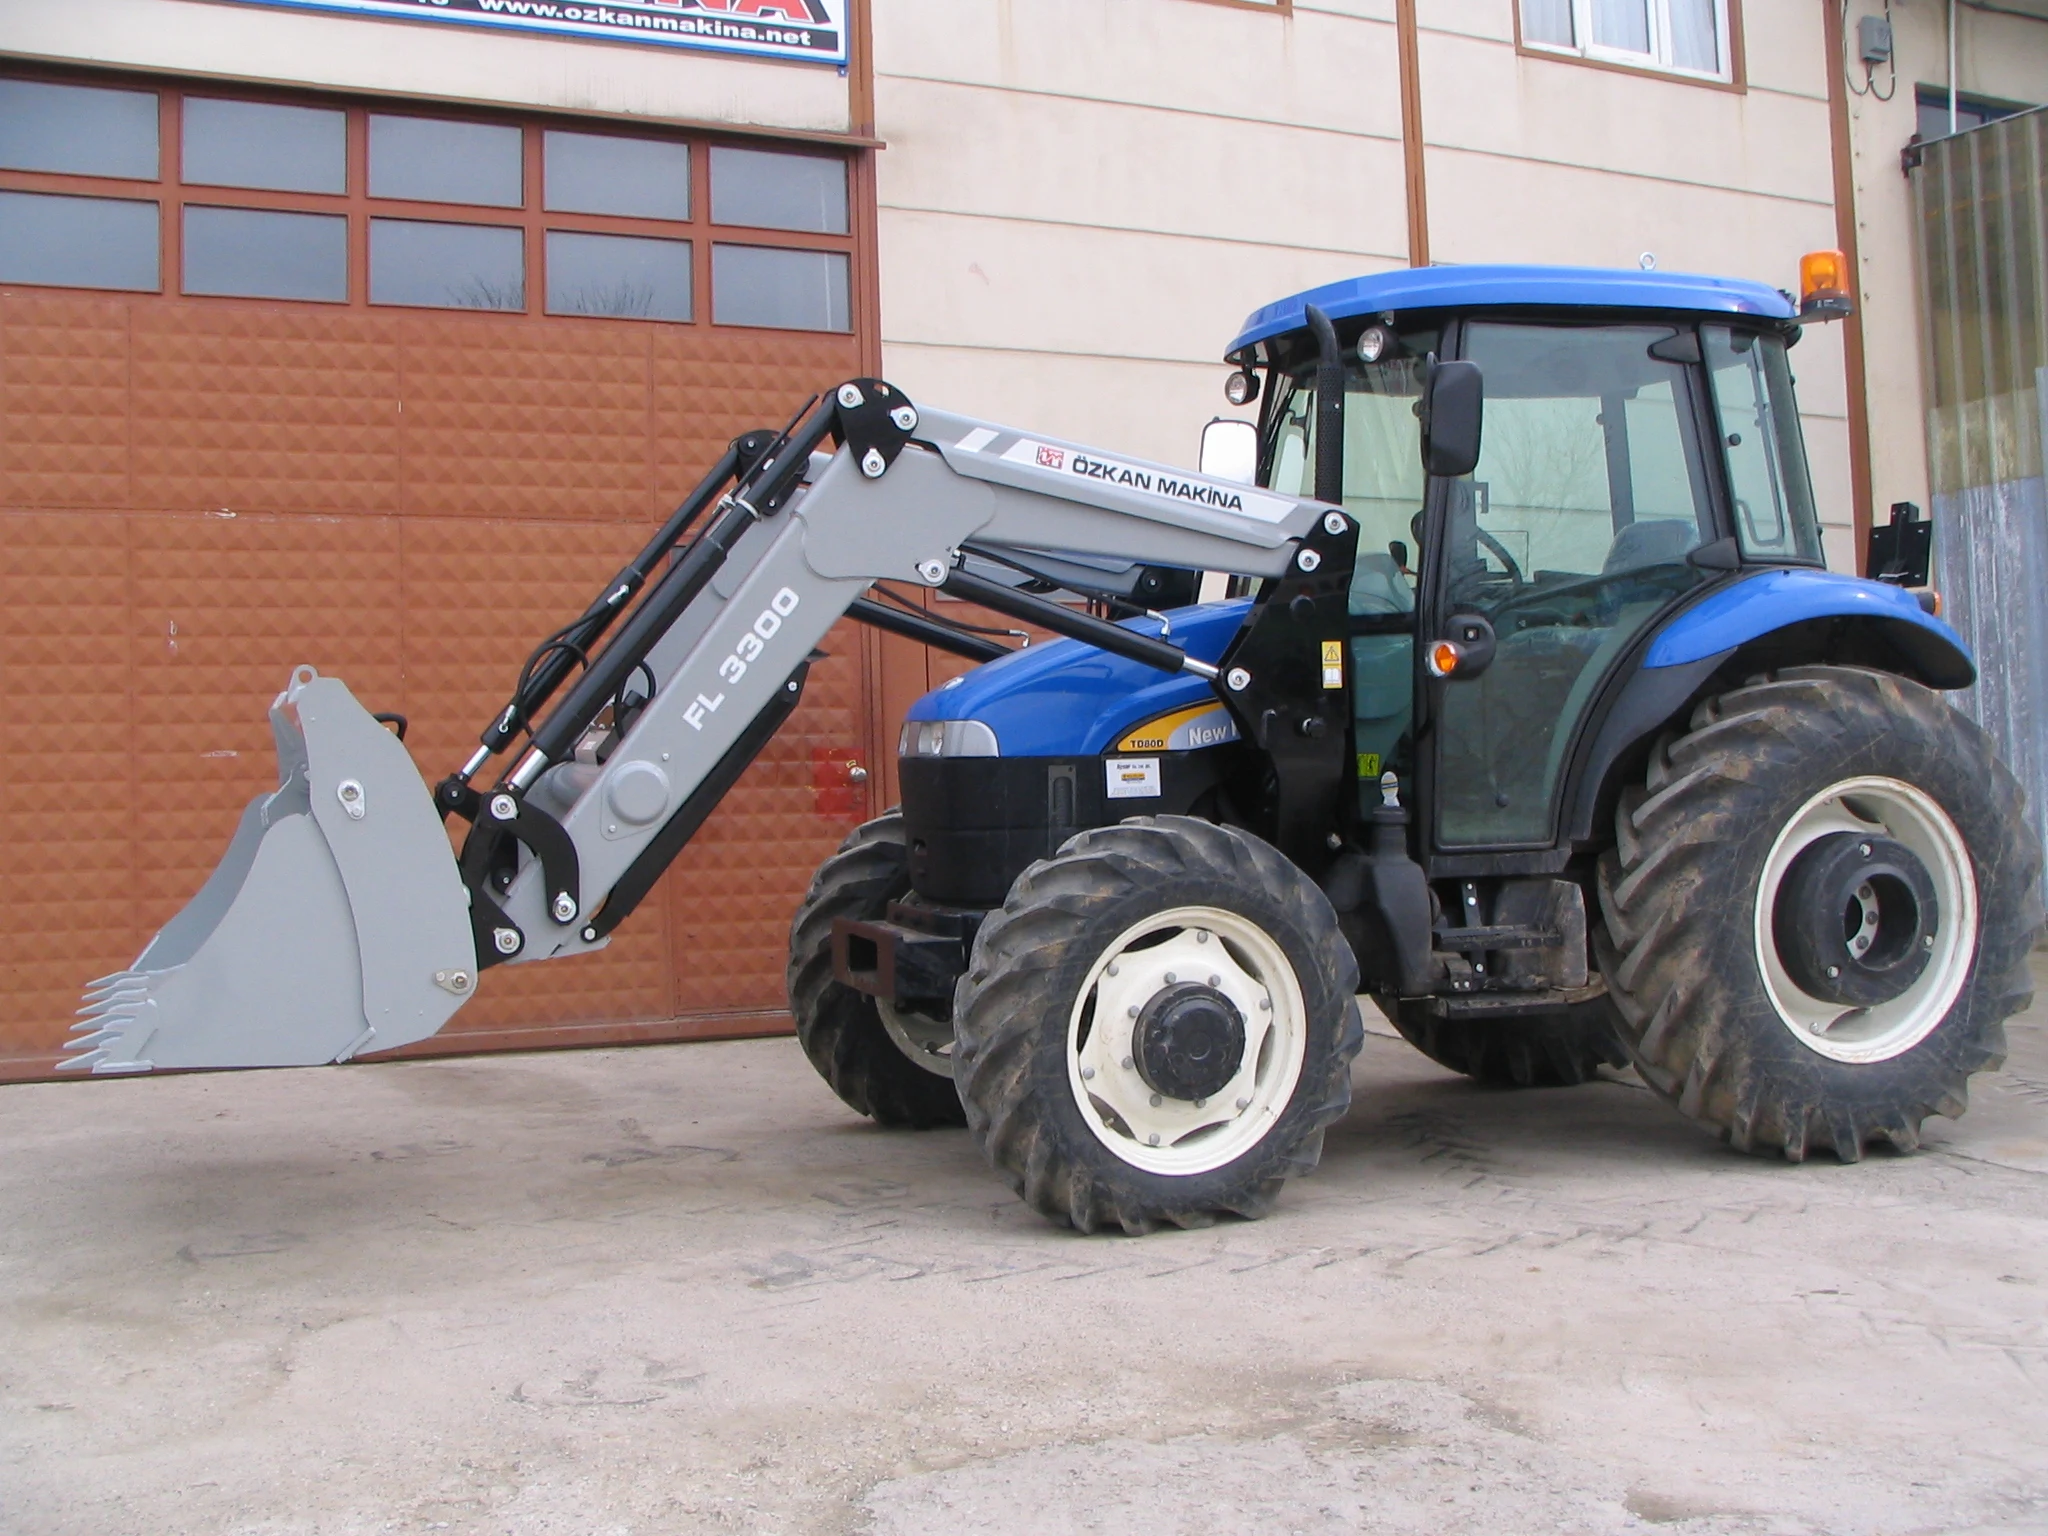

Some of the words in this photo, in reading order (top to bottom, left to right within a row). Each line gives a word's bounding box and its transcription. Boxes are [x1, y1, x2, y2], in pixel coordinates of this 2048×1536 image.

[477, 0, 812, 46] www.ozkanmakina.net
[1072, 455, 1151, 489] ÖZKAN
[1157, 478, 1243, 511] MAKİNA
[682, 693, 725, 731] FL
[719, 587, 800, 684] 3300
[1130, 739, 1164, 748] TD80D
[1188, 726, 1227, 746] New
